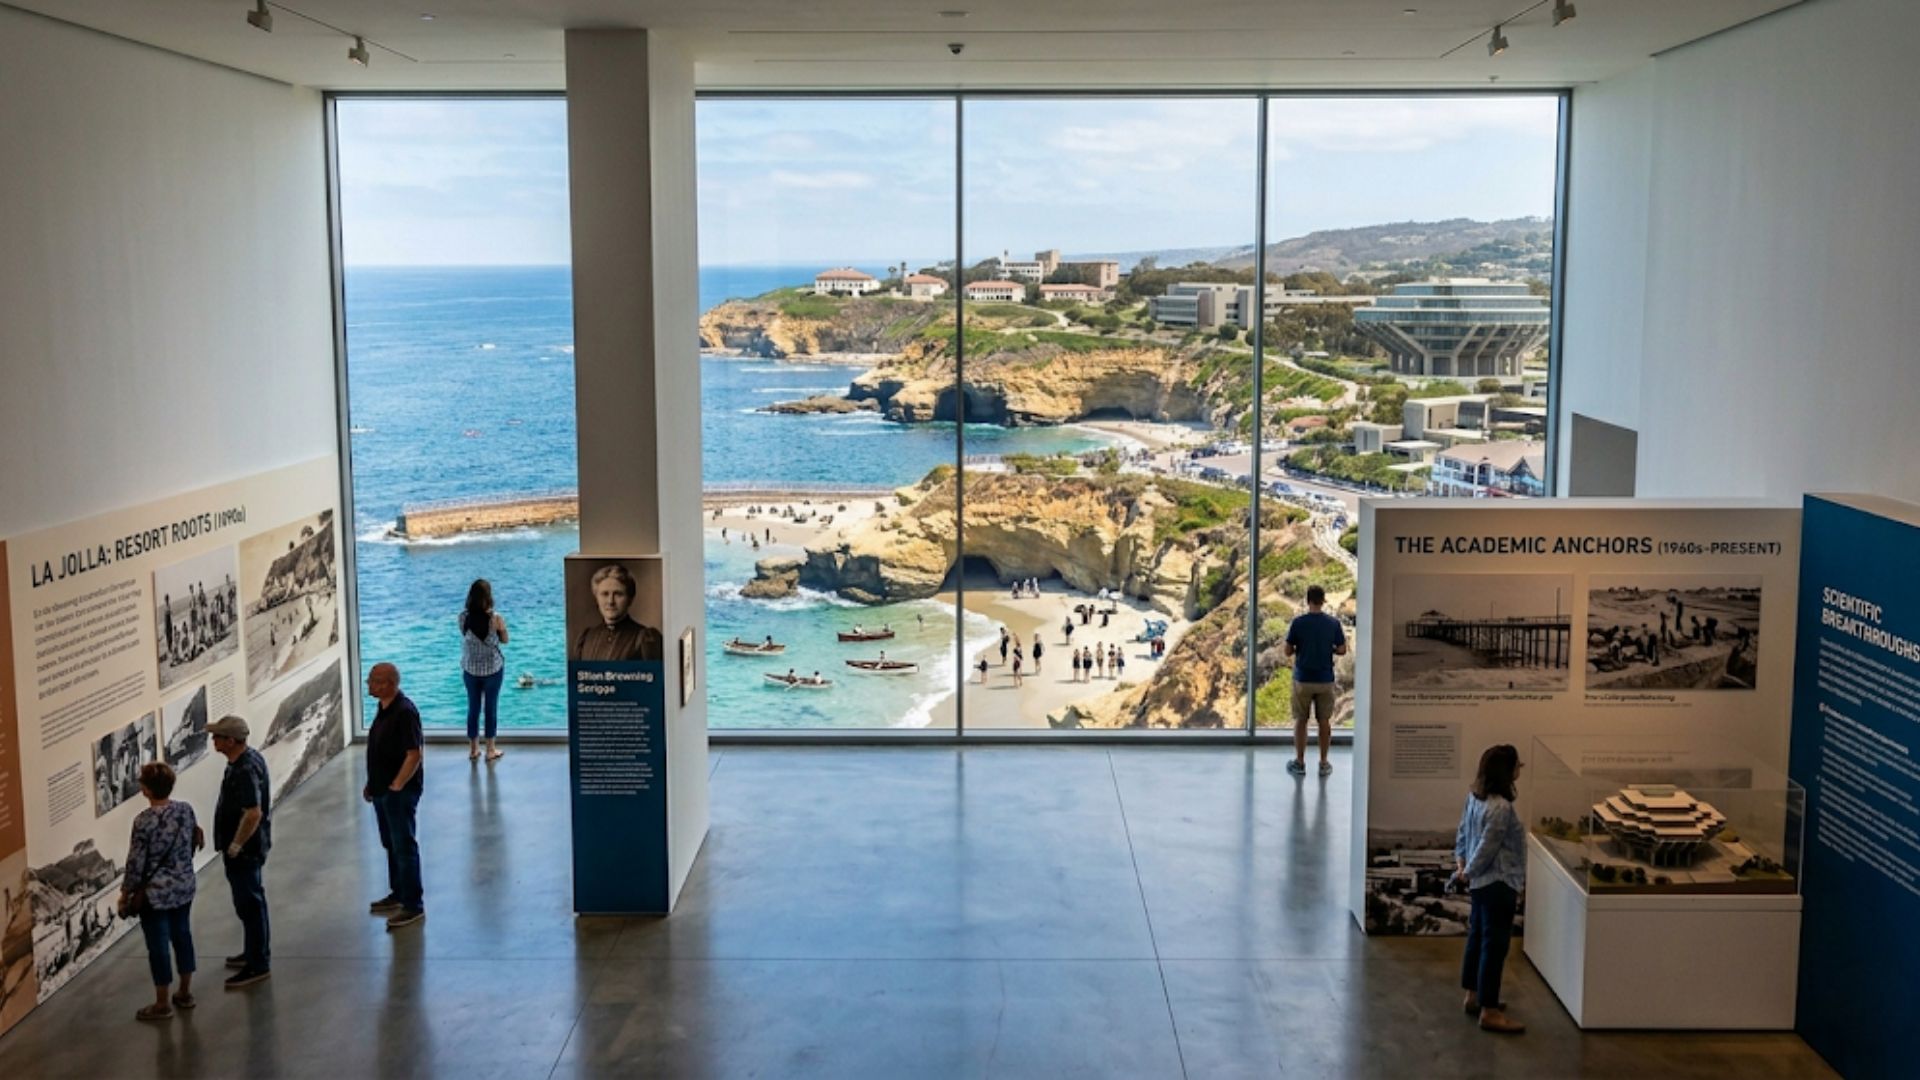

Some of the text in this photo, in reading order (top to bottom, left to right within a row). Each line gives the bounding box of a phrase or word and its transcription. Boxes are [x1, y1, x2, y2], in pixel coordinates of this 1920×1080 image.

[31, 561, 54, 588] LA
[58, 544, 112, 580] JOLLA:
[115, 525, 169, 562] RESORT
[171, 512, 212, 543] ROOTS
[1394, 536, 1435, 554] THE
[1440, 536, 1546, 554] ACADEMIC
[1552, 536, 1653, 554] ANCHORS
